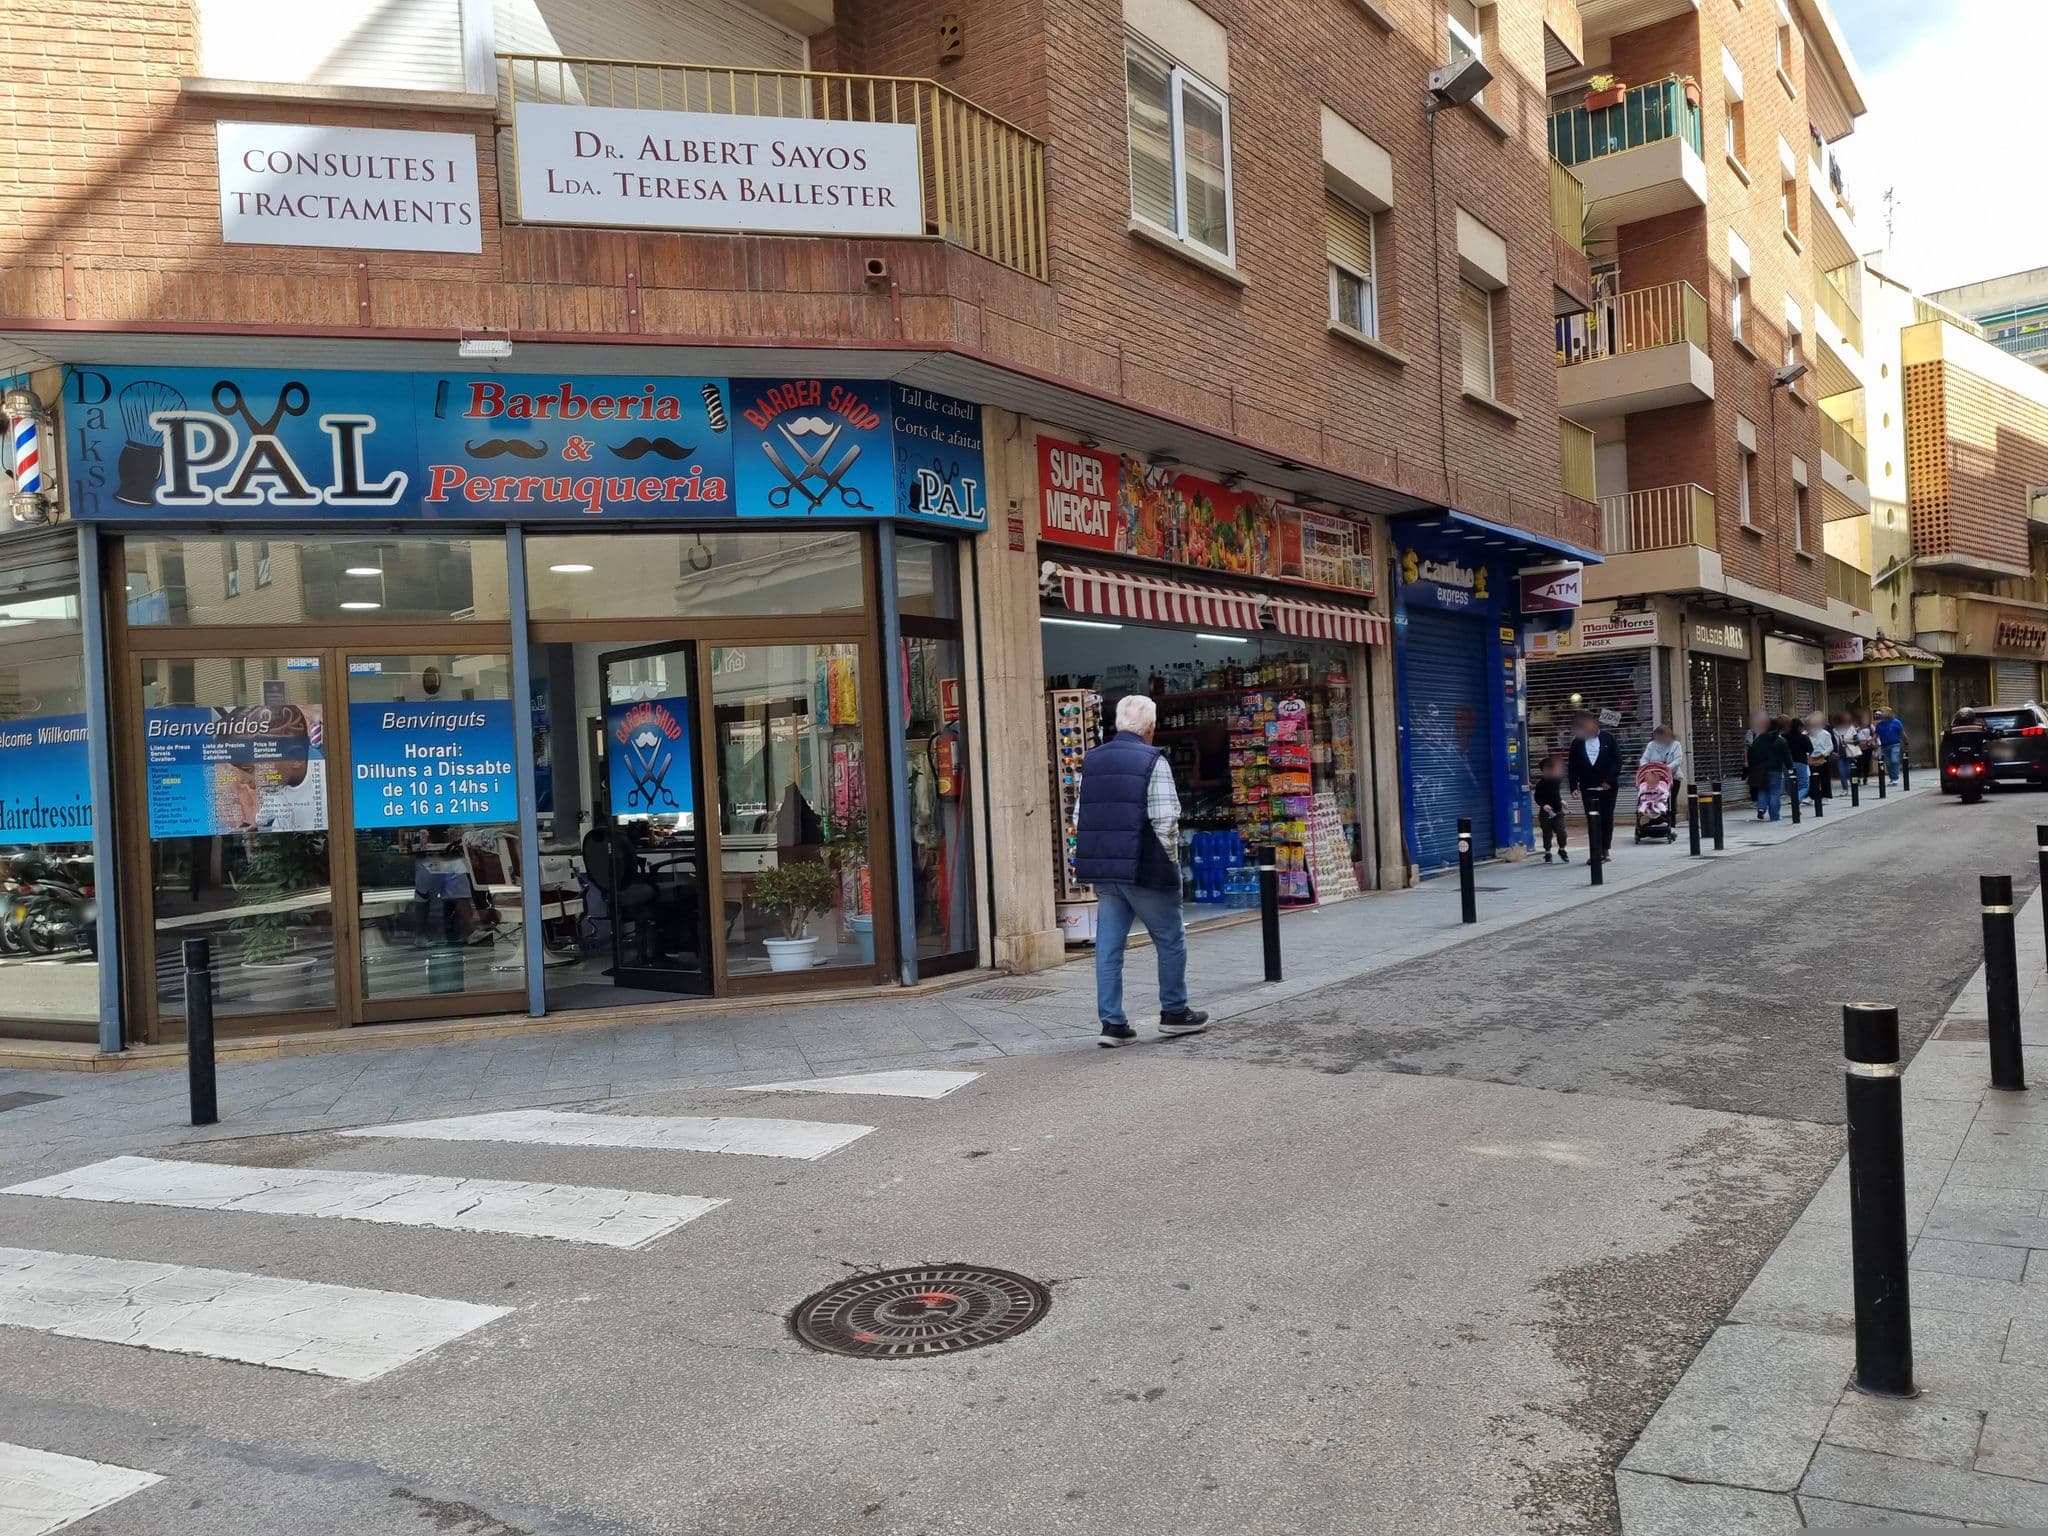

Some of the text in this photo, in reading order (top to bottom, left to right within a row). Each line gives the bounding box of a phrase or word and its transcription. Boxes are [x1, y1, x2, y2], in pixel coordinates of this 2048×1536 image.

[243, 149, 456, 183] CONSULTES I
[637, 134, 759, 166] ALBERT
[771, 140, 868, 171] SAYOS
[613, 171, 729, 202] TERESA
[739, 177, 897, 208] BALLESTER
[231, 191, 472, 226] TRACTAMENTS
[462, 381, 682, 421] Barberia
[743, 380, 882, 431] BARBER SHOP
[900, 386, 973, 420] Tall de cabell
[562, 435, 595, 462] &
[894, 415, 982, 451] Corts de afaitat
[149, 410, 409, 506] PAL
[1050, 448, 1105, 497] SUPER
[424, 464, 728, 514] Perruqueria
[917, 468, 985, 523] PAL
[1046, 489, 1112, 538] MERCAT
[1437, 586, 1469, 607] express
[1546, 582, 1578, 596] ATM
[1695, 624, 1723, 646] BOLSOS
[148, 717, 270, 738] Bienvenidos
[382, 711, 486, 732] Benvinguts
[616, 701, 682, 745] BARBER SHOP
[404, 742, 463, 759] Horari:
[357, 760, 512, 779] Dilluns a Dissabte
[382, 778, 499, 797] de 10 a 14hs i
[383, 798, 490, 816] de 16 a 21hs
